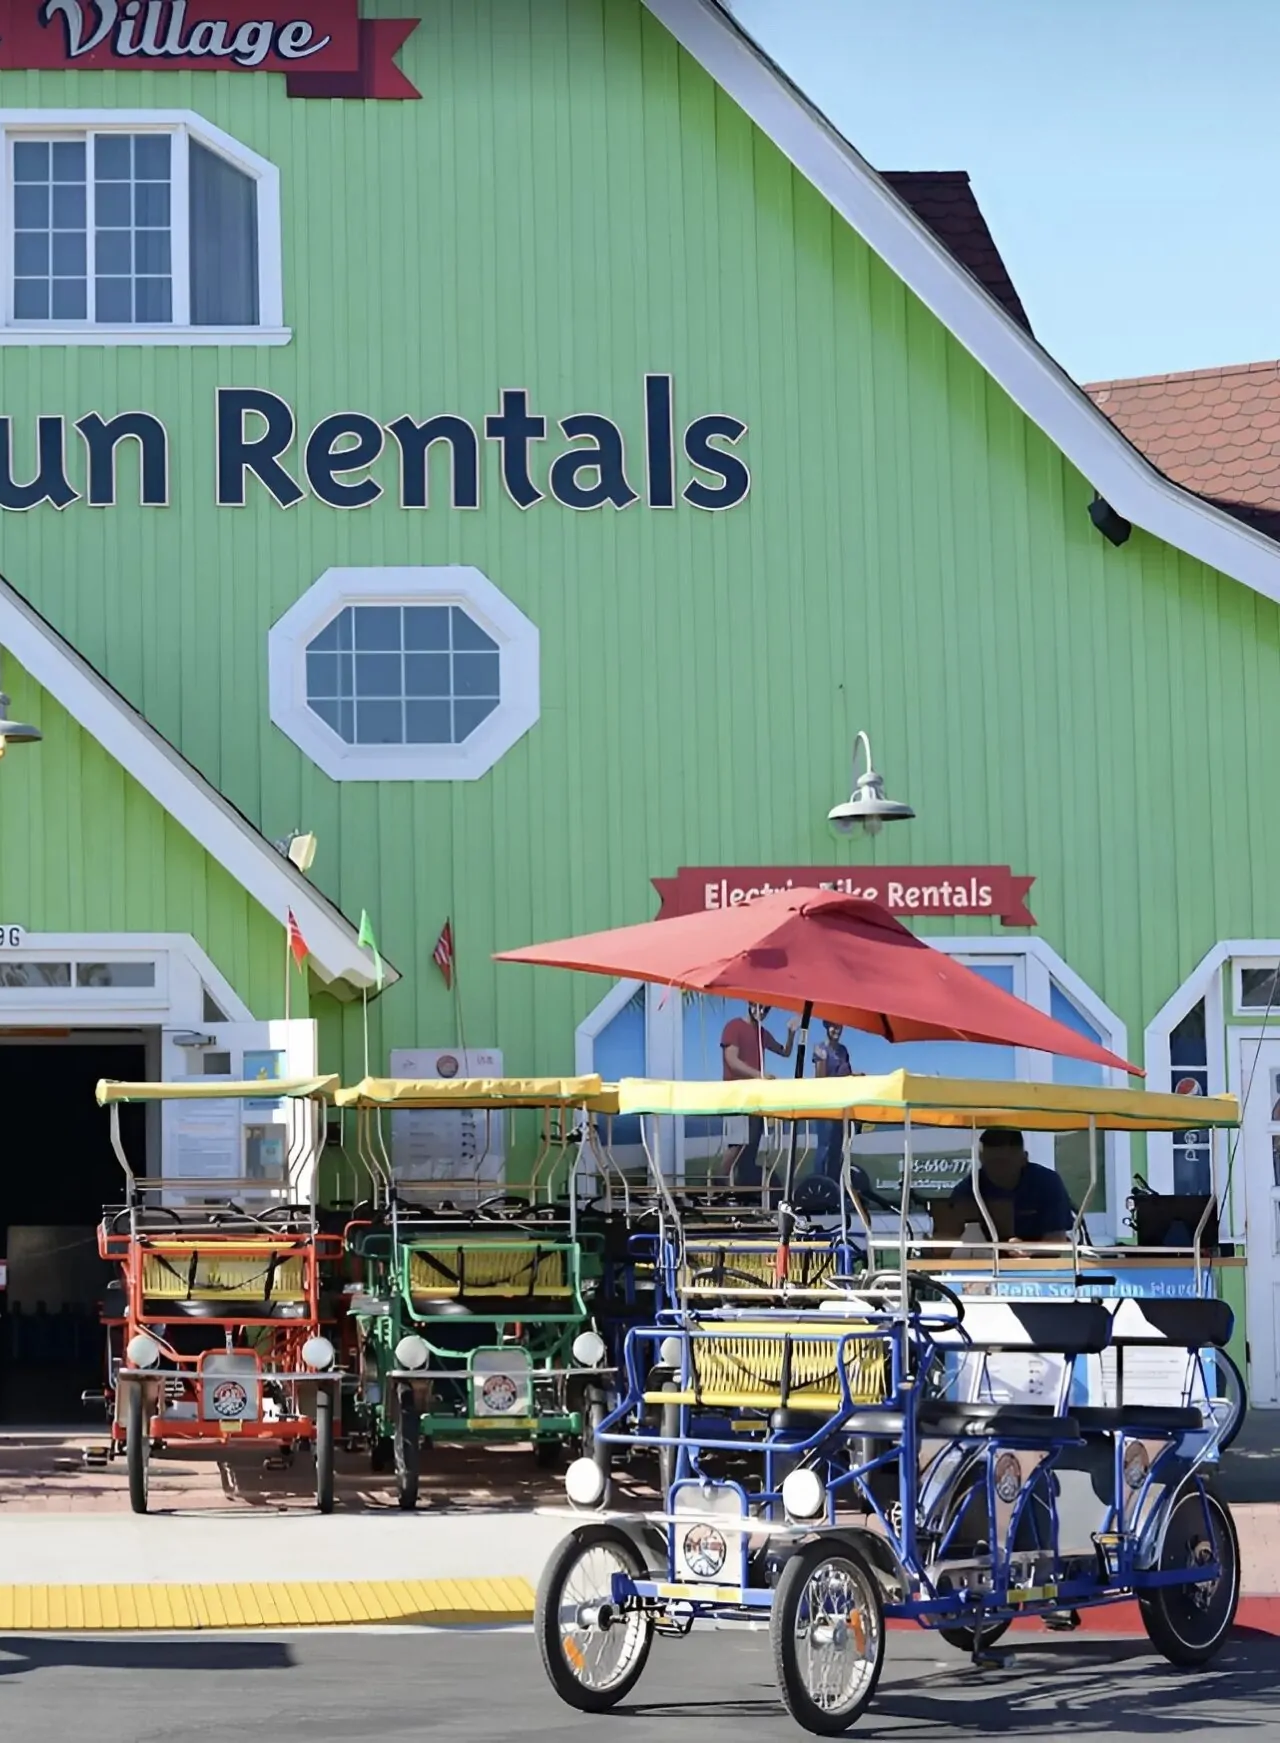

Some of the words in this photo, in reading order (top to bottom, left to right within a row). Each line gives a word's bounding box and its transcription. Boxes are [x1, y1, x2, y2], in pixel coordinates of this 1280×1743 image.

[40, 0, 331, 66] Village
[215, 372, 752, 511] Rentals
[888, 878, 992, 909] Rentals
[9, 927, 20, 947] G
